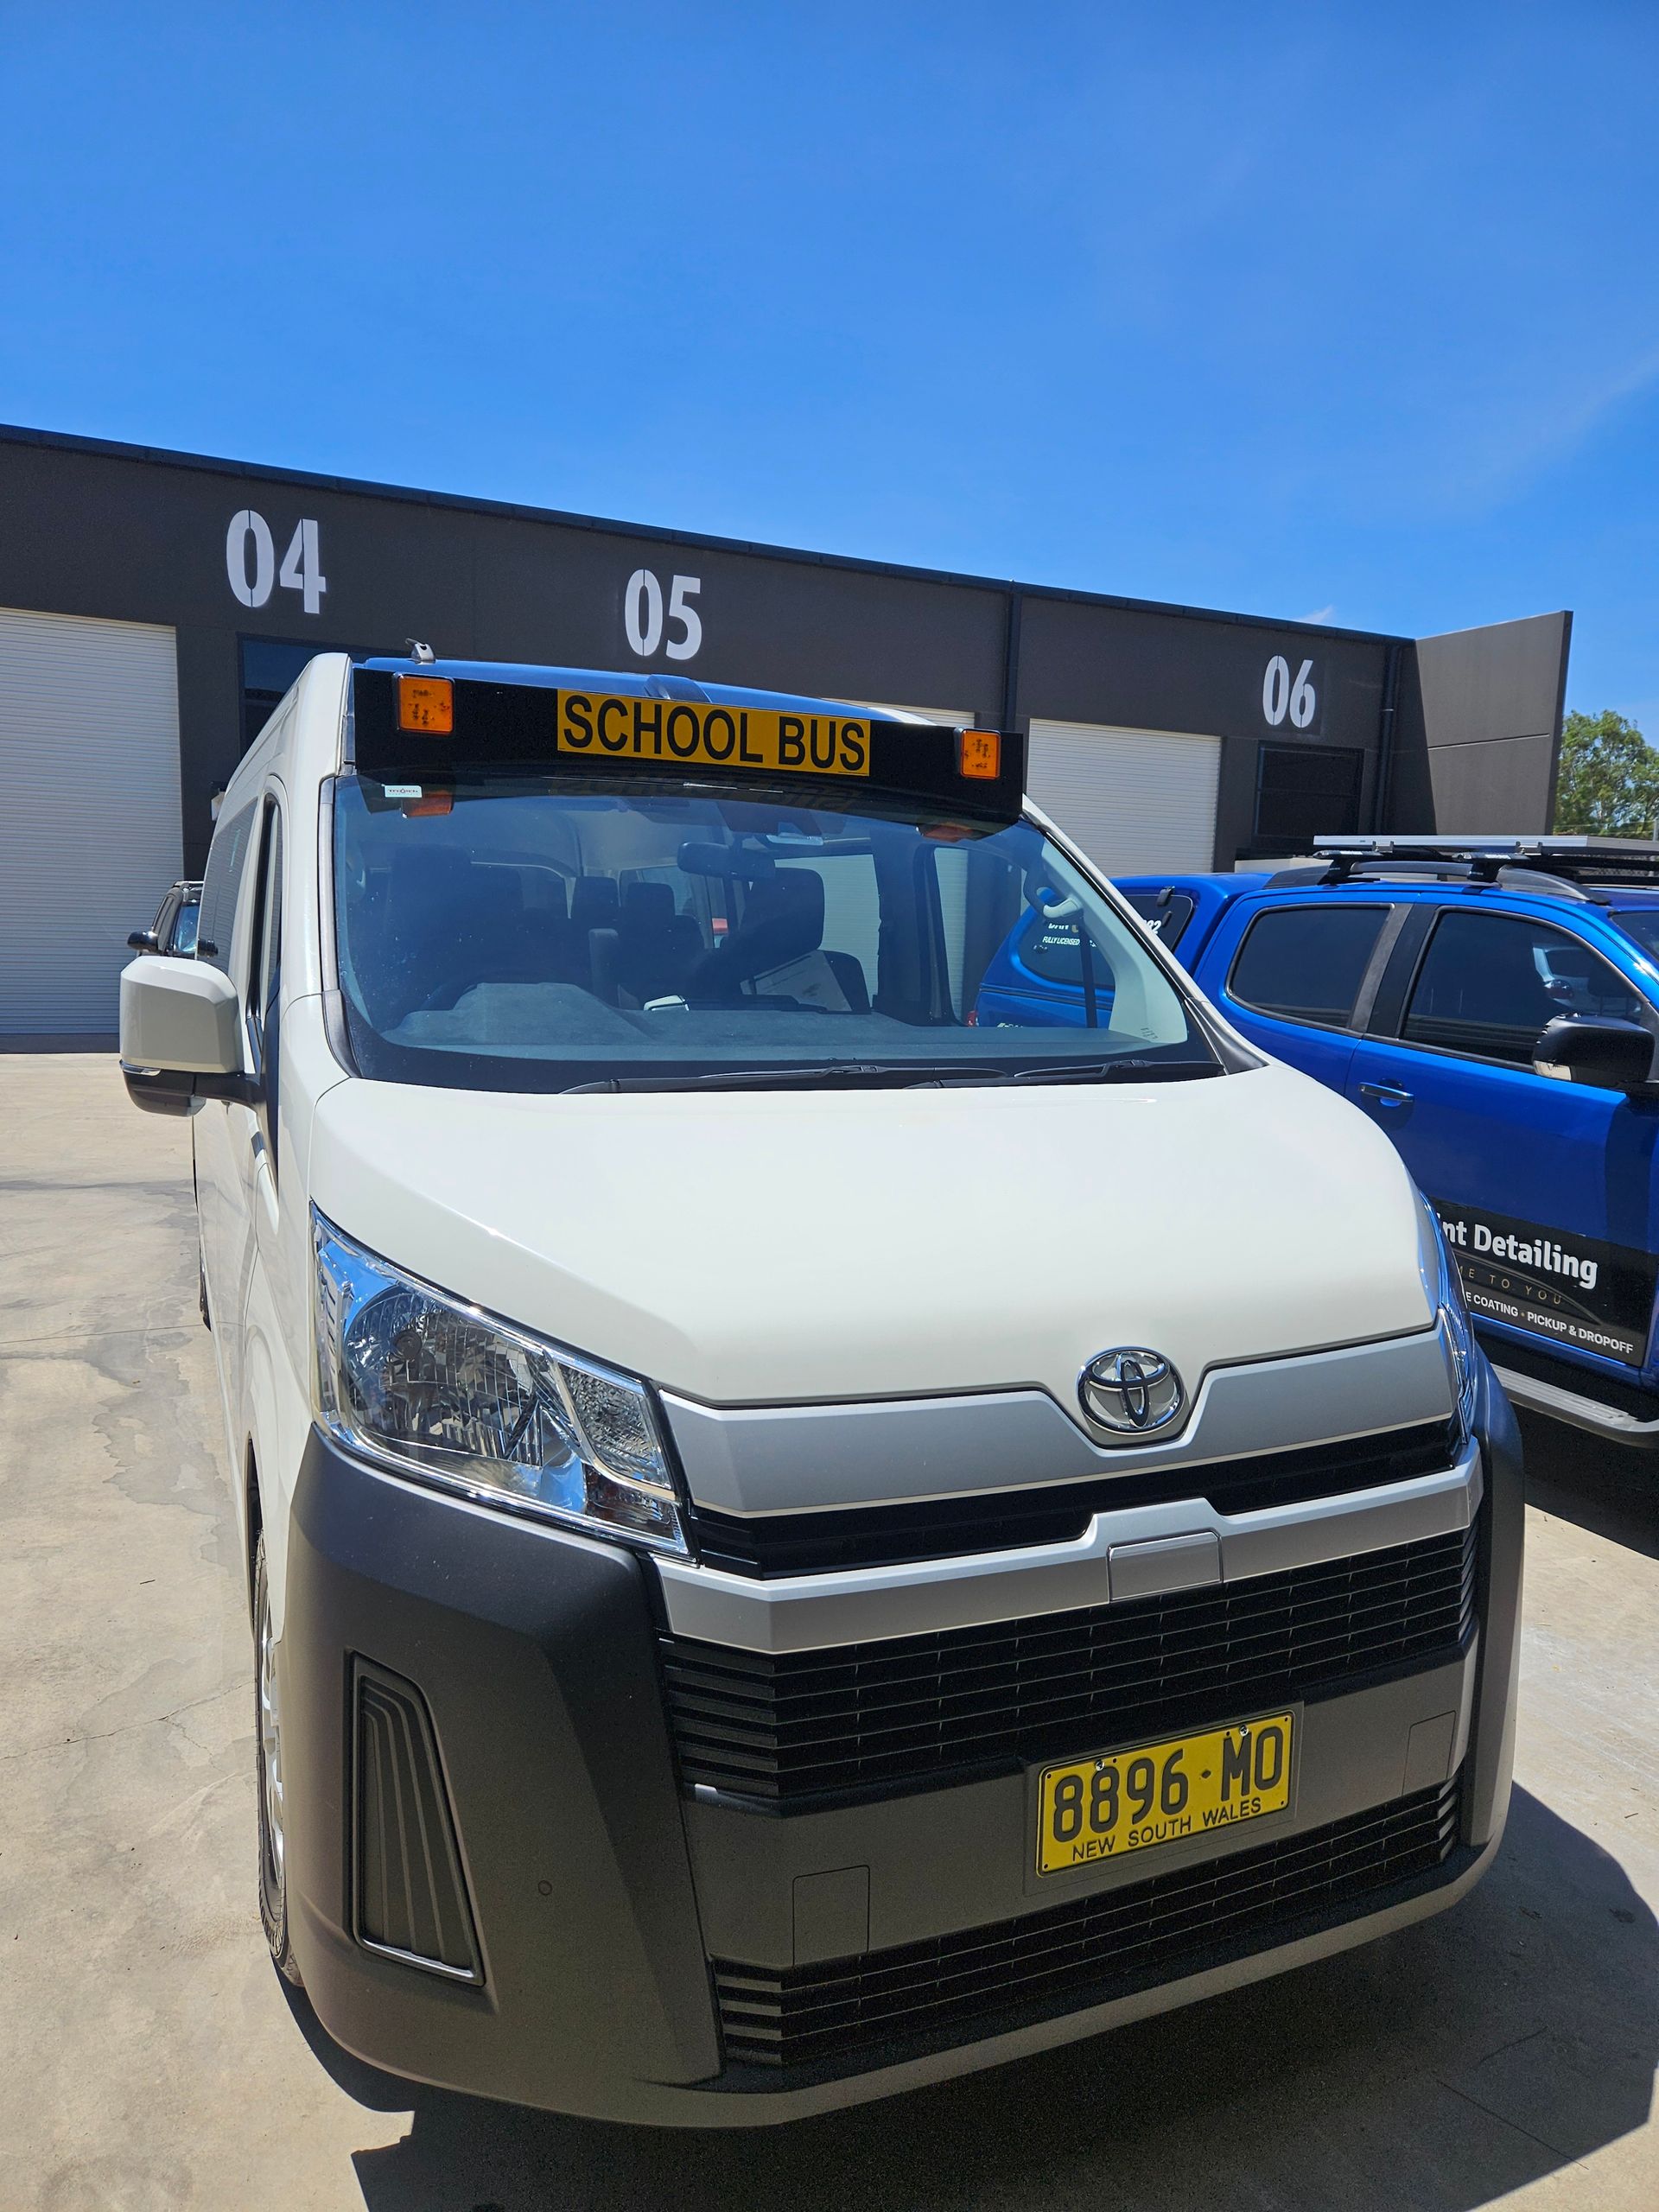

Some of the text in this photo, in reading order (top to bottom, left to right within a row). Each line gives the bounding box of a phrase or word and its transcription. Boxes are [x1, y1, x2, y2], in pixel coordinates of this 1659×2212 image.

[226, 509, 327, 614] 04
[625, 569, 702, 660] 05
[1262, 655, 1316, 728] 06
[563, 695, 865, 771] SCHOOL BUS
[1437, 1212, 1599, 1289] nt Detailing
[1473, 1294, 1519, 1318] COATING
[1527, 1311, 1567, 1332] PICKUP
[1569, 1325, 1577, 1336] &
[1579, 1327, 1634, 1354] DROPOFF
[1489, 1274, 1511, 1289] TO
[1525, 1285, 1562, 1305] YOU
[1072, 1797, 1262, 1862] NEW SOUTH WALES
